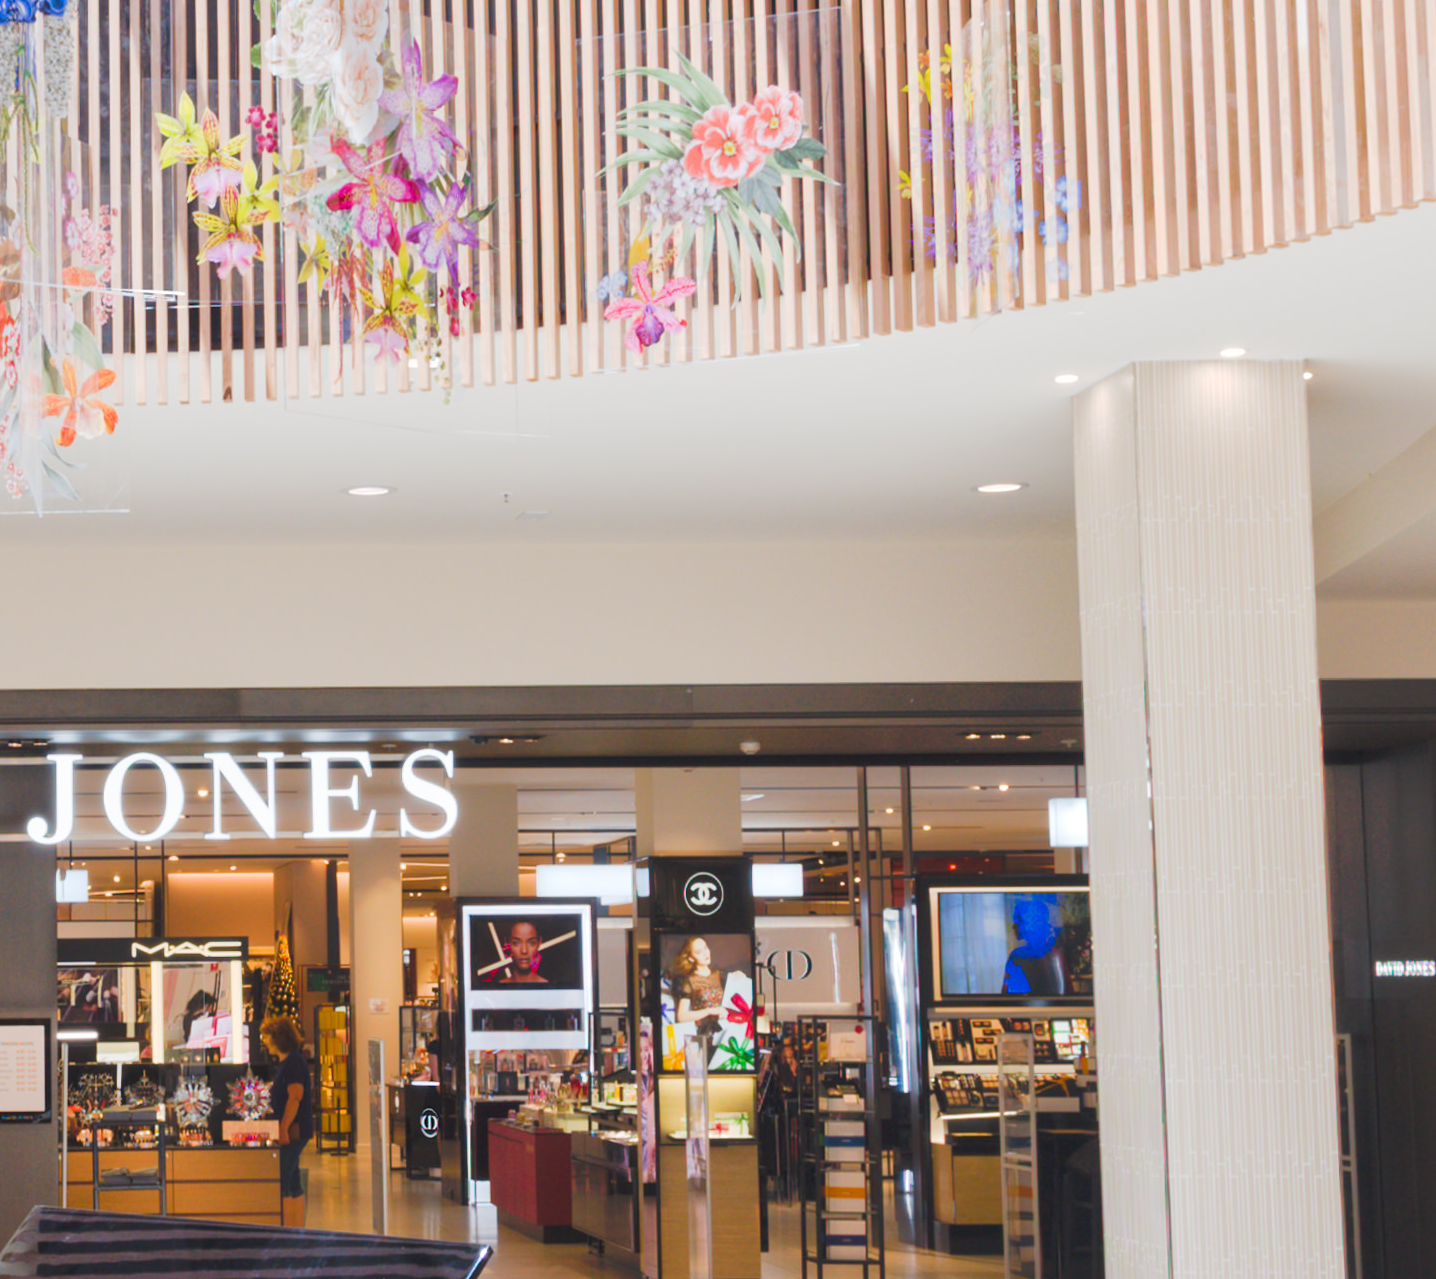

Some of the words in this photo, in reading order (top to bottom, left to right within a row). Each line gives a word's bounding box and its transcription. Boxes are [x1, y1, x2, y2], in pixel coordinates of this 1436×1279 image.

[27, 749, 460, 845] JONES
[1375, 960, 1404, 977] DAVID
[1405, 960, 1436, 977] JONES
